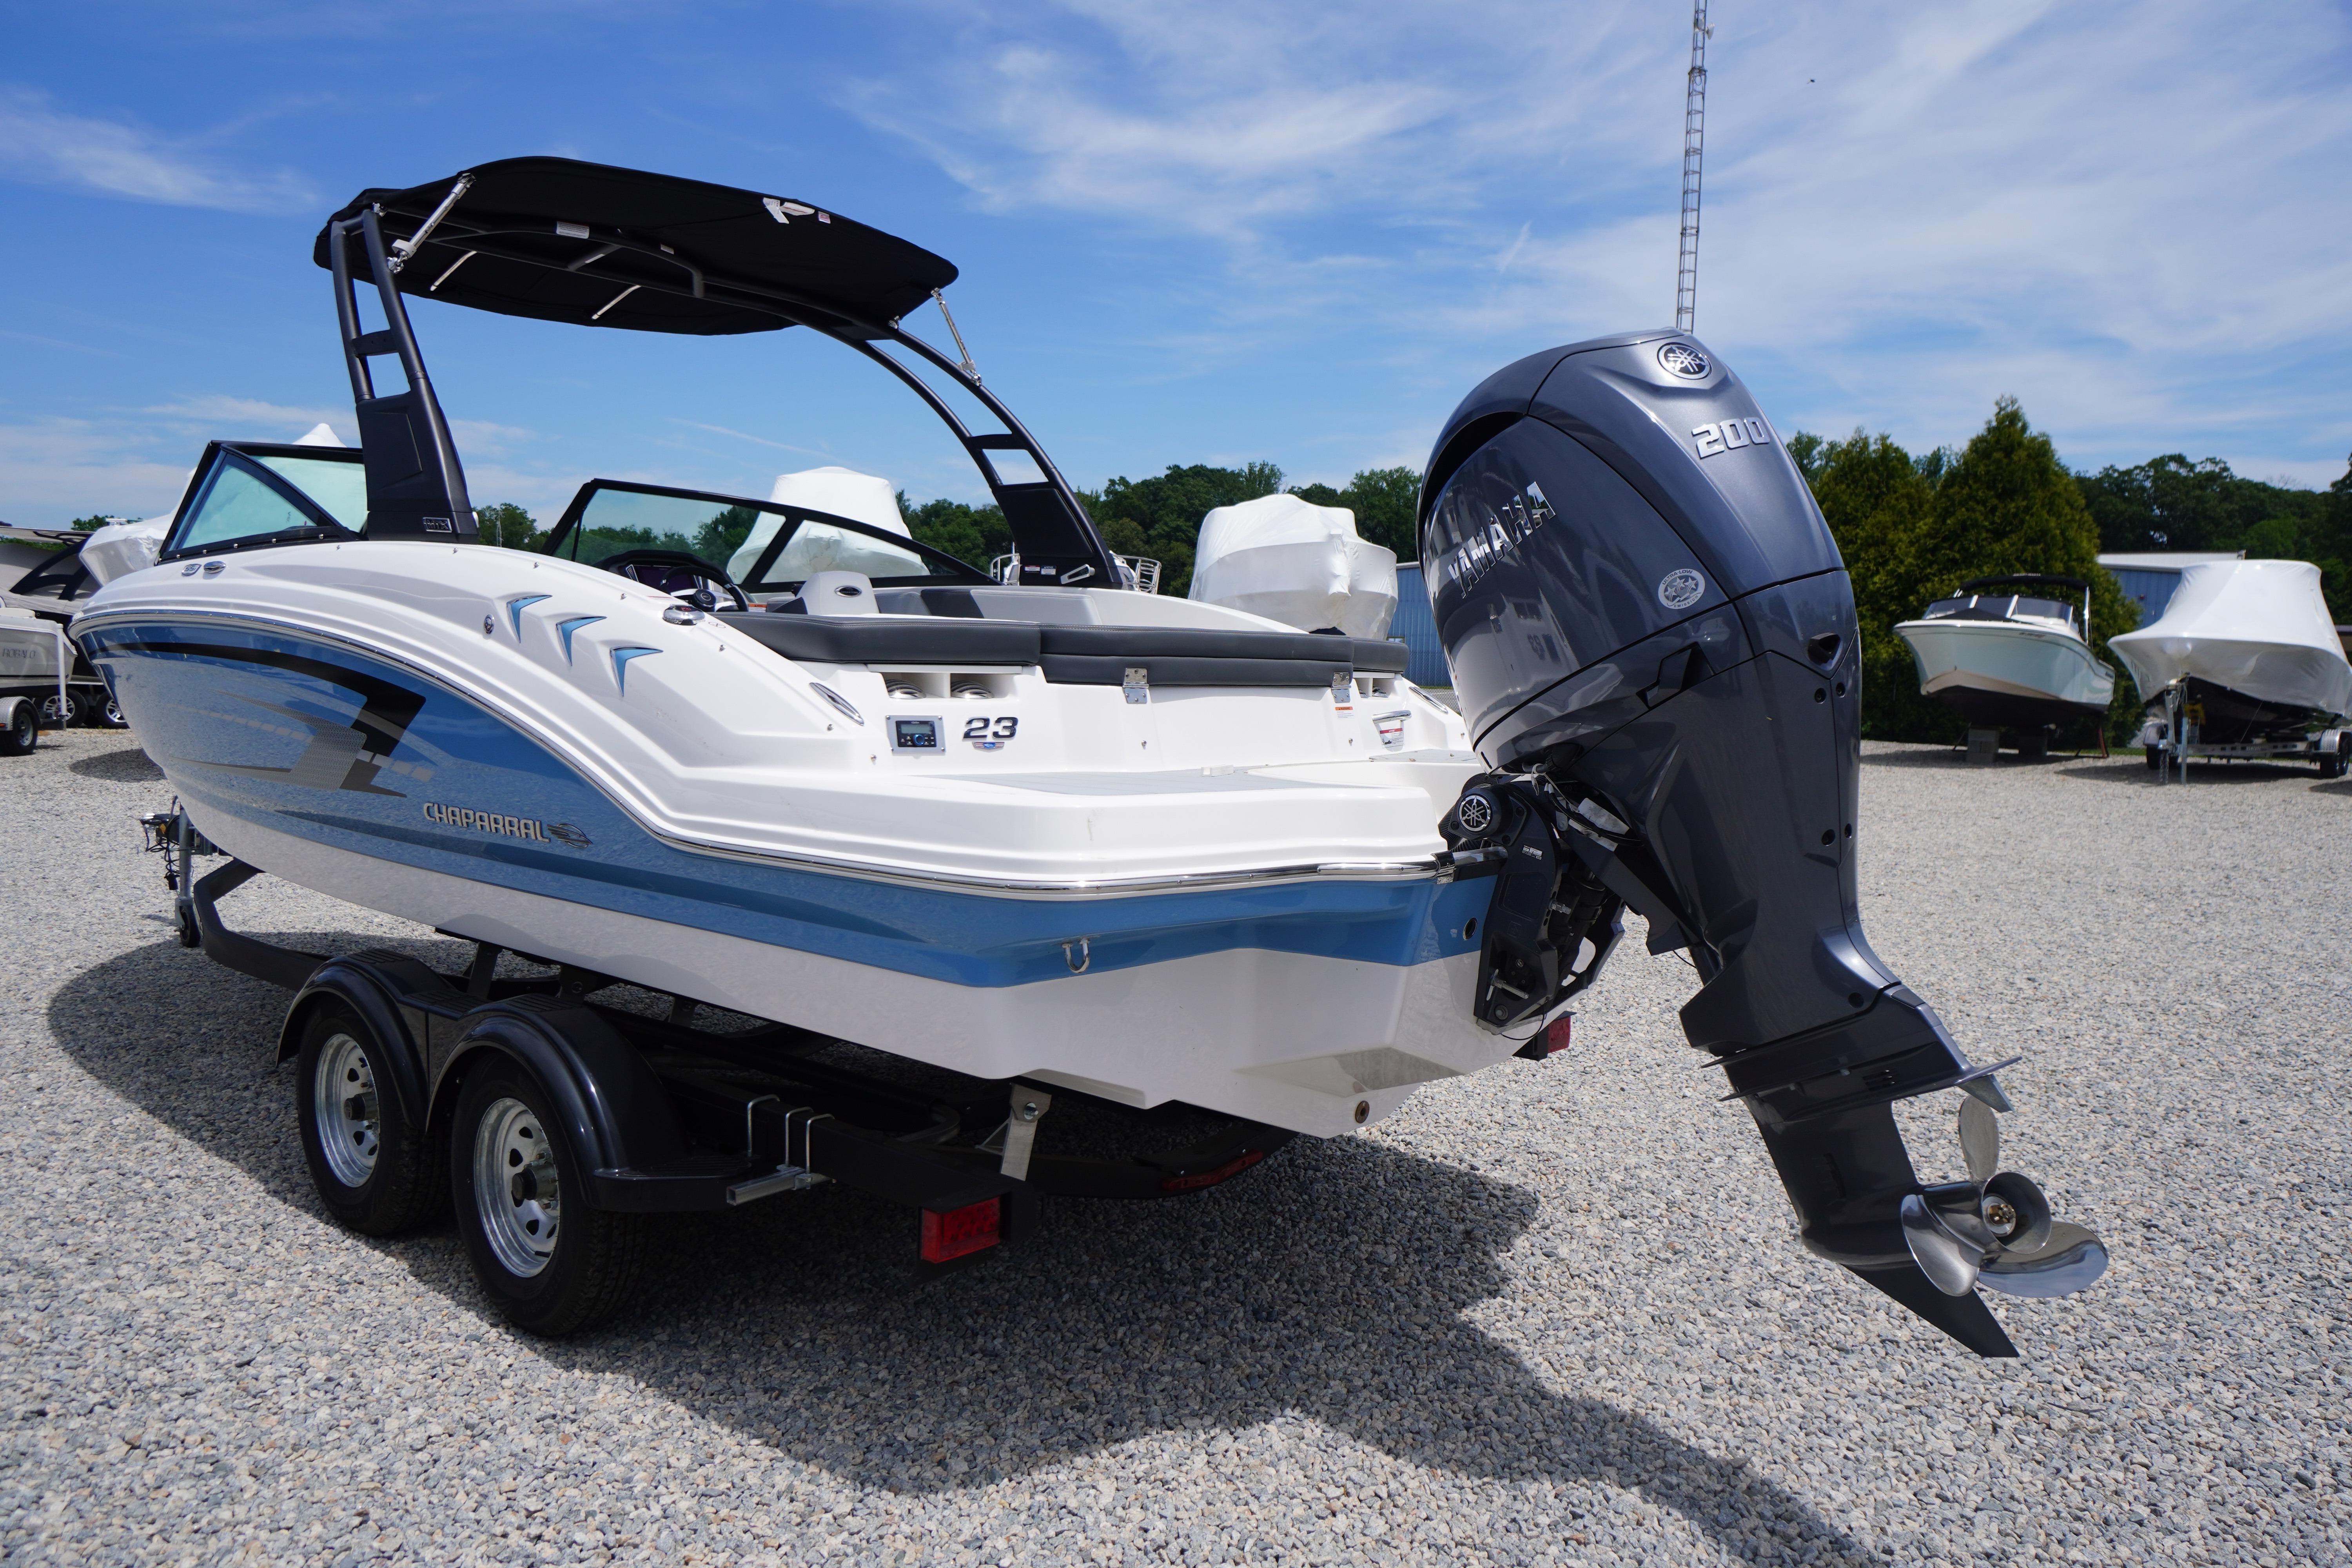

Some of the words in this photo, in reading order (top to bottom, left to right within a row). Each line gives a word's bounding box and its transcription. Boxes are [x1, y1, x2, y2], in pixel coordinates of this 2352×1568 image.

[1691, 417, 1770, 459] 200
[426, 519, 449, 530] MTX
[1448, 481, 1556, 599] YAMAHA
[1674, 595, 1699, 608] EMISSION
[963, 717, 1018, 740] 23
[423, 801, 551, 843] CHAPARRAL
